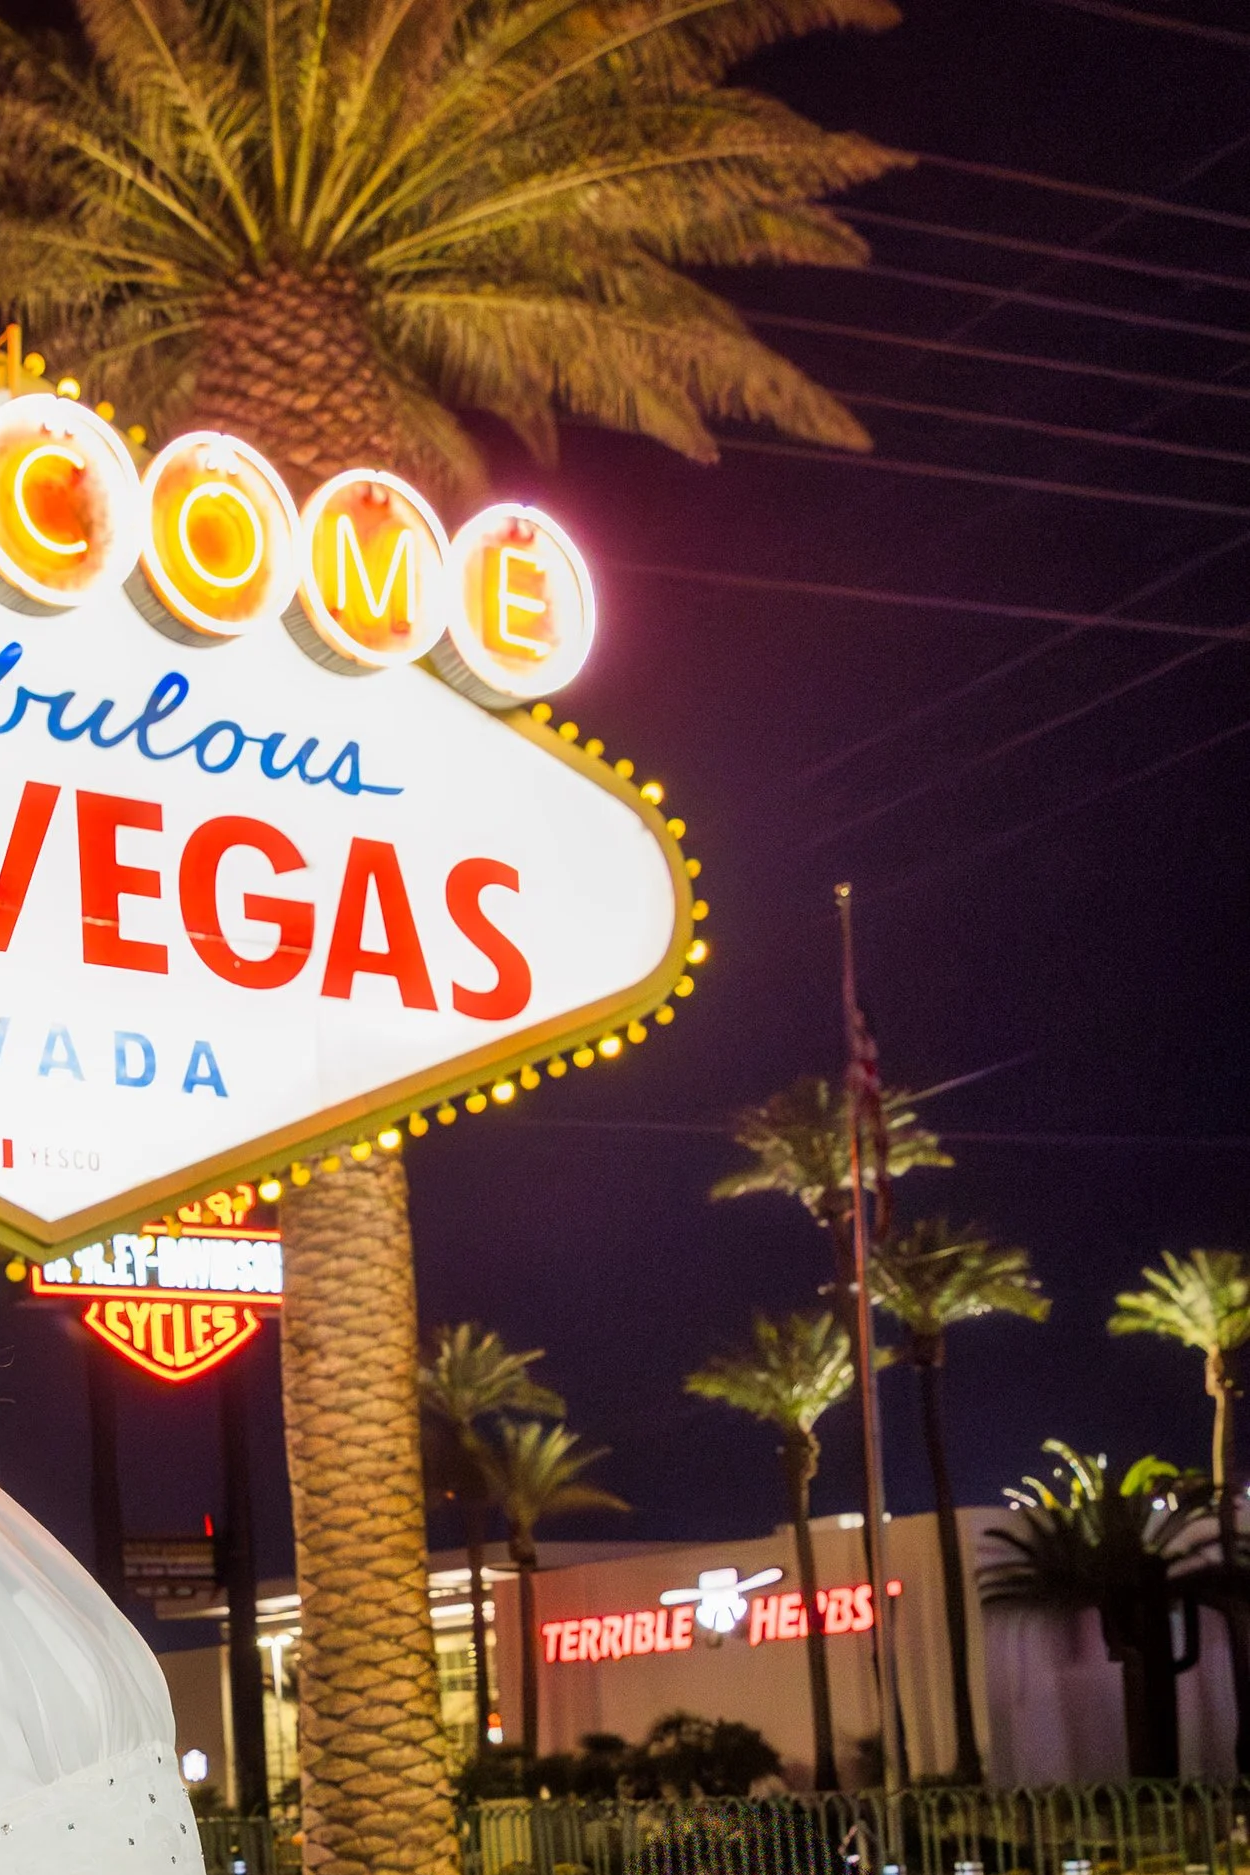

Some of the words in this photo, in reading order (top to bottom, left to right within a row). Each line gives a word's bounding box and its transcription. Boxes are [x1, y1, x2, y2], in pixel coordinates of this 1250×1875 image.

[29, 1146, 100, 1172] YESCO
[104, 1301, 237, 1367] CYCLES
[542, 1606, 694, 1663] TERRIBLE
